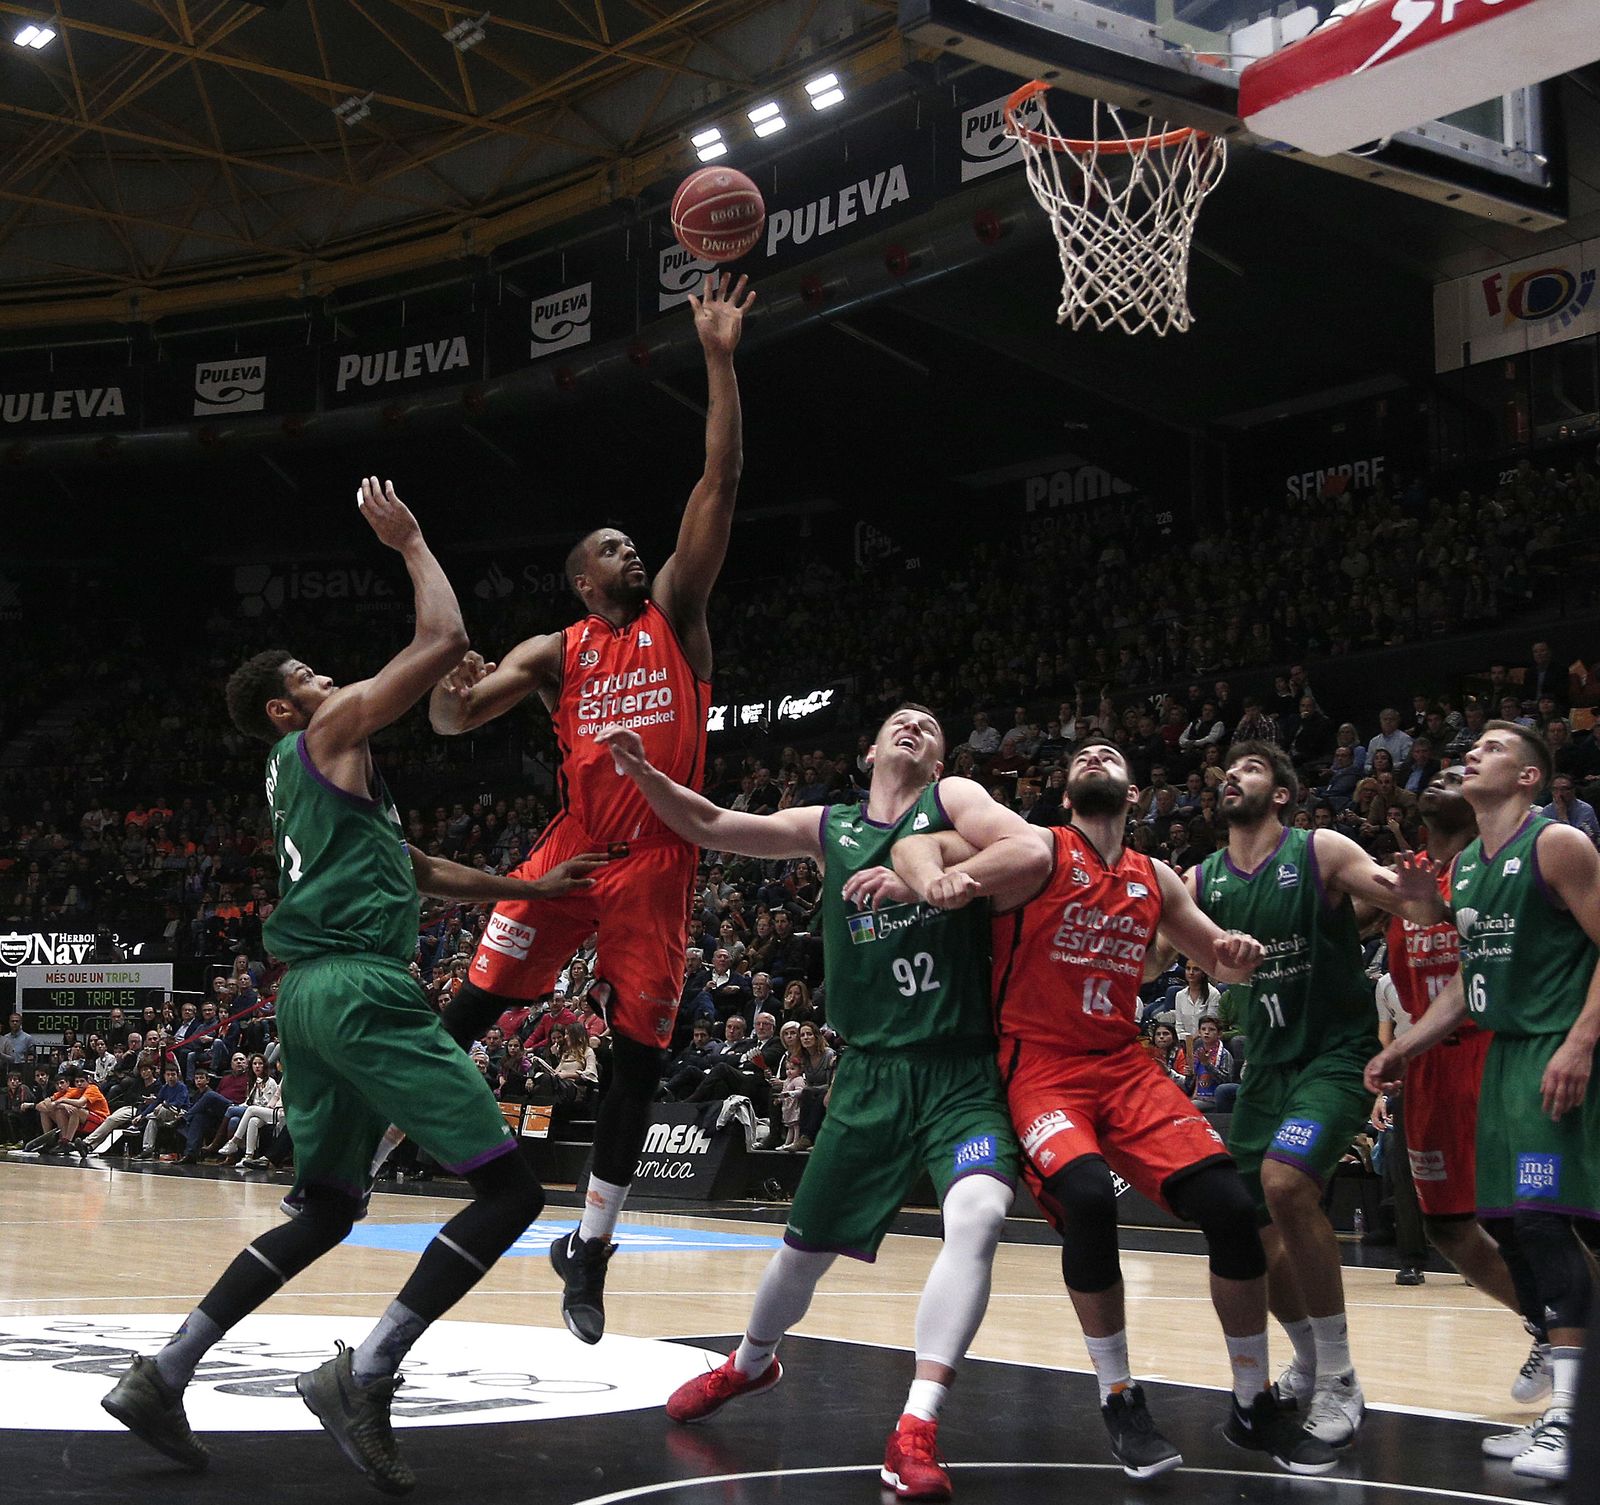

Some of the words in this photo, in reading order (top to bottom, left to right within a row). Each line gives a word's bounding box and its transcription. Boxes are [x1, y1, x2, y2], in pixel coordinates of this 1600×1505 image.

[766, 164, 910, 257] PULEVA
[534, 293, 588, 323] PULEVA
[199, 366, 262, 385] PULEVA
[336, 336, 470, 392] PULEVA
[0, 387, 126, 424] ULEVA
[581, 668, 646, 698] Cultura
[649, 667, 667, 683] del
[578, 687, 672, 720] Esfuerzo
[479, 793, 492, 807] 101
[491, 917, 531, 941] PULEVA
[1053, 924, 1146, 962] Esfuerzo
[46, 969, 66, 983] MÉS
[68, 973, 87, 983] QUE
[90, 973, 104, 983] UN
[106, 972, 141, 983] TRIPL3
[892, 952, 941, 997] 92
[50, 991, 75, 1007] 403
[86, 991, 136, 1007] TRIPLES
[1259, 993, 1286, 1029] 11
[37, 1015, 79, 1031] 20250
[1520, 1169, 1554, 1189] laga
[1525, 1158, 1554, 1176] má
